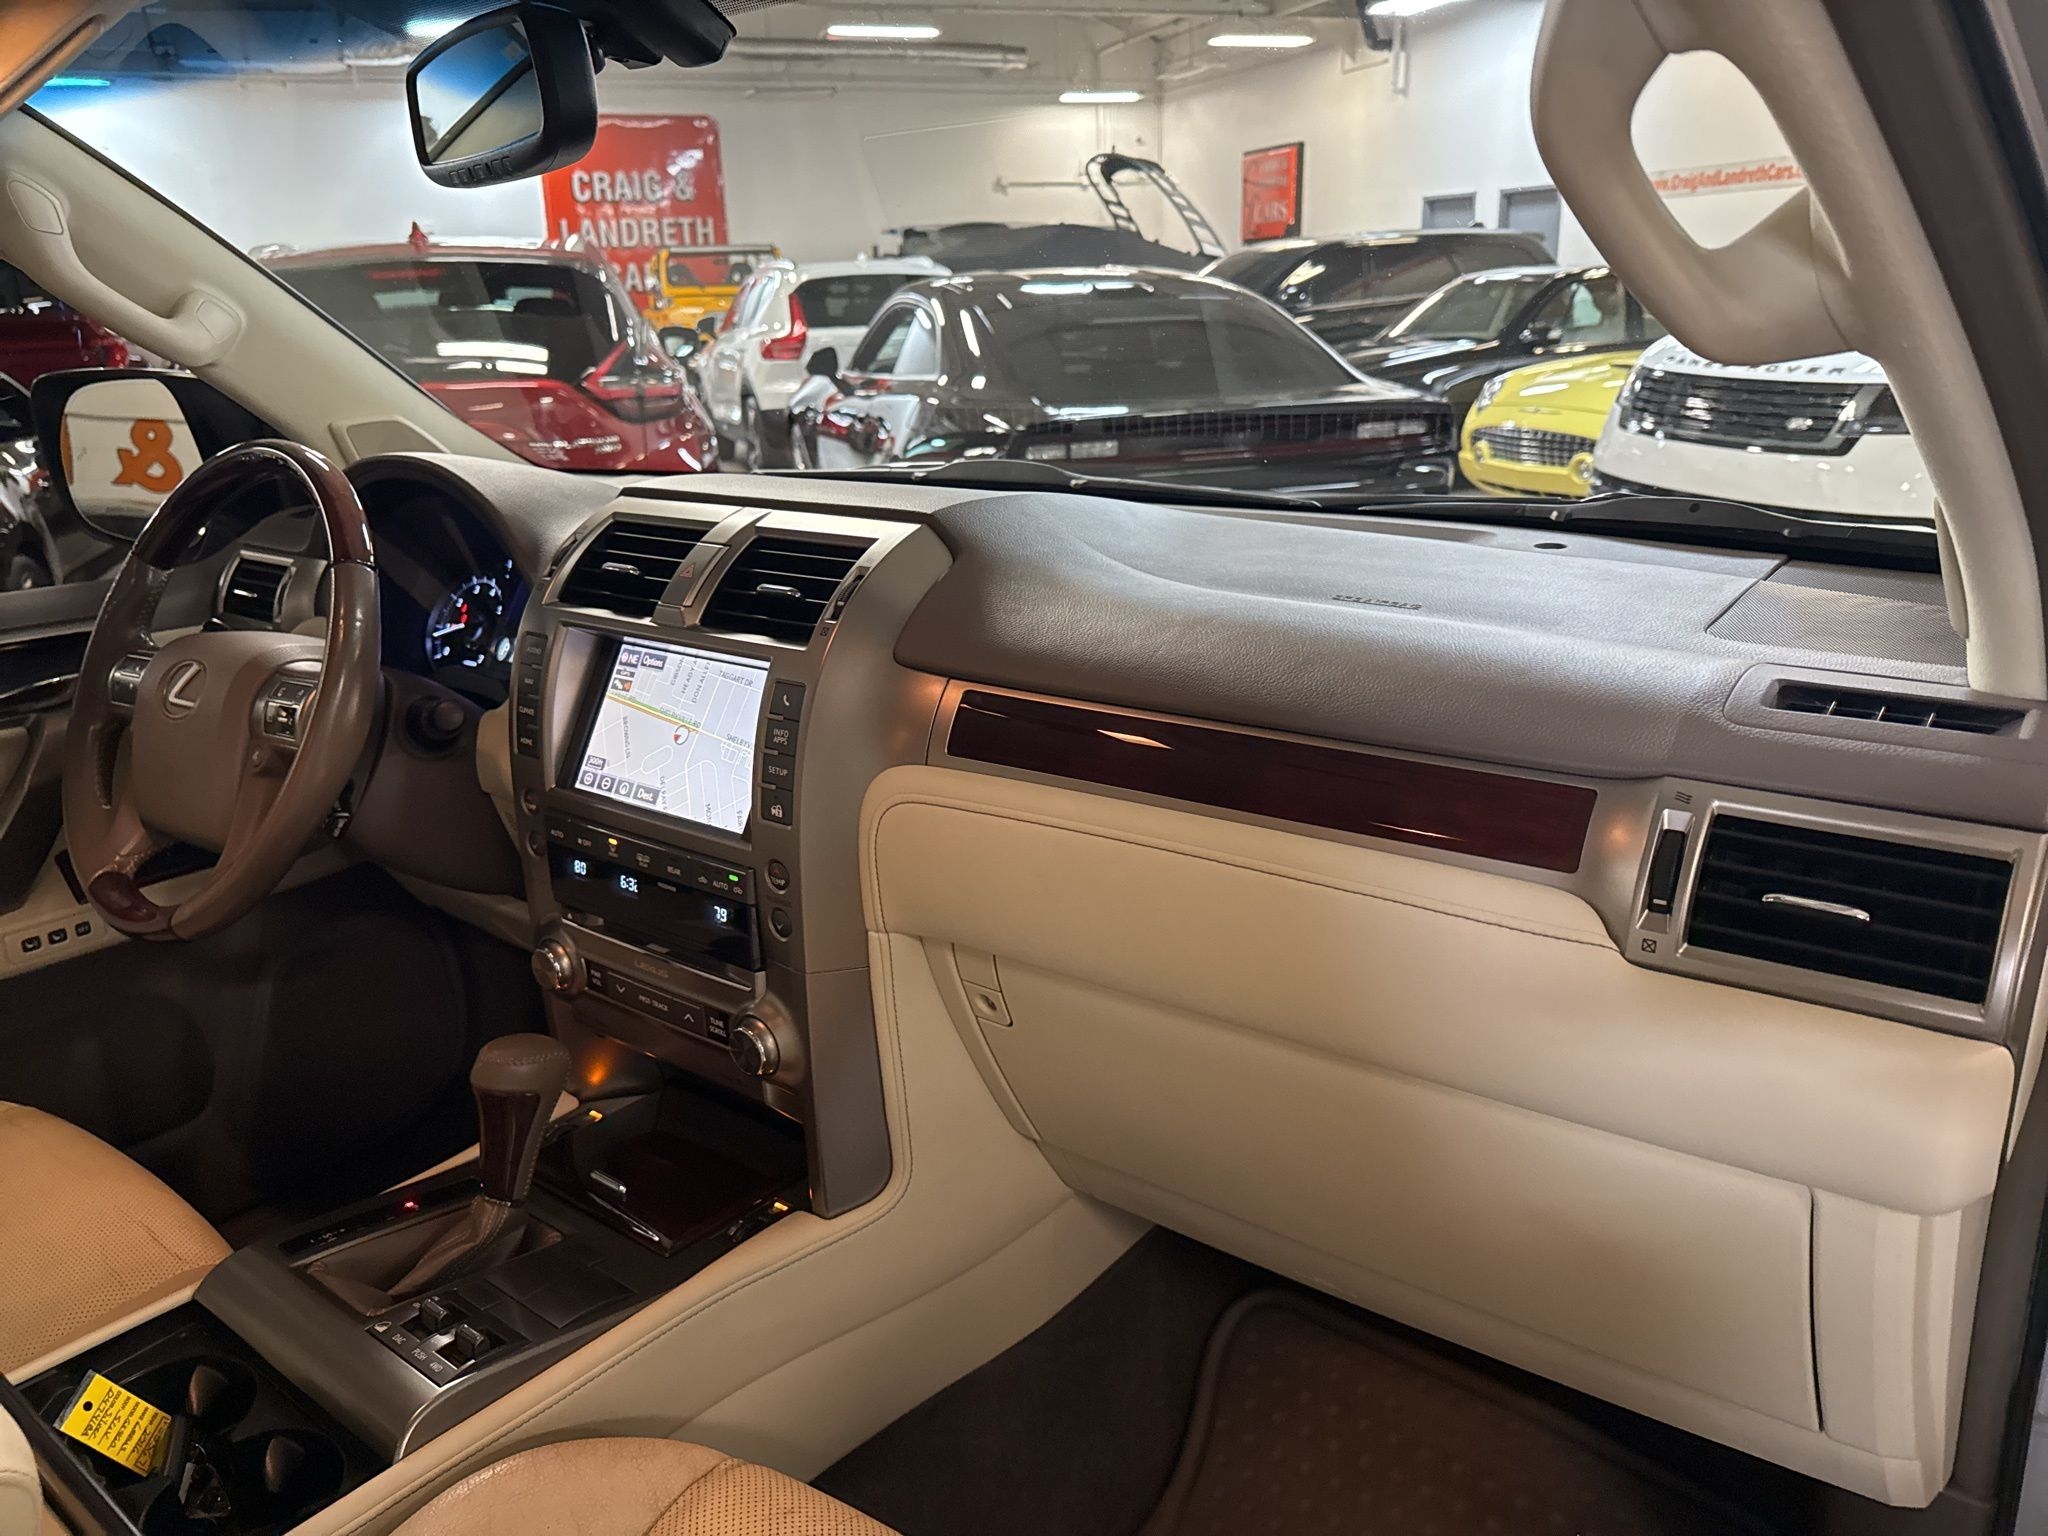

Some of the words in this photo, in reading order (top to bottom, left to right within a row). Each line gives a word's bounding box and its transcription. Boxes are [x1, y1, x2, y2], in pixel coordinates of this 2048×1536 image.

[571, 168, 662, 202] CRAIG
[674, 171, 695, 201] &
[560, 216, 715, 249] LANDRETH
[628, 653, 639, 664] NE
[643, 654, 664, 669] Options
[670, 657, 685, 686] GIBSON
[719, 670, 743, 686] TAGGART
[681, 666, 696, 695] HEADY
[692, 684, 703, 704] DON
[772, 736, 789, 746] APPS
[773, 729, 789, 739] INFO
[768, 765, 789, 777] SETUP
[637, 787, 654, 802] Dest.
[573, 859, 588, 876] 80
[712, 879, 729, 891] AUTO
[713, 905, 728, 923] 79
[710, 1016, 724, 1028] TUNE
[709, 1025, 727, 1038] SCROLL
[411, 1348, 428, 1361] PUSH
